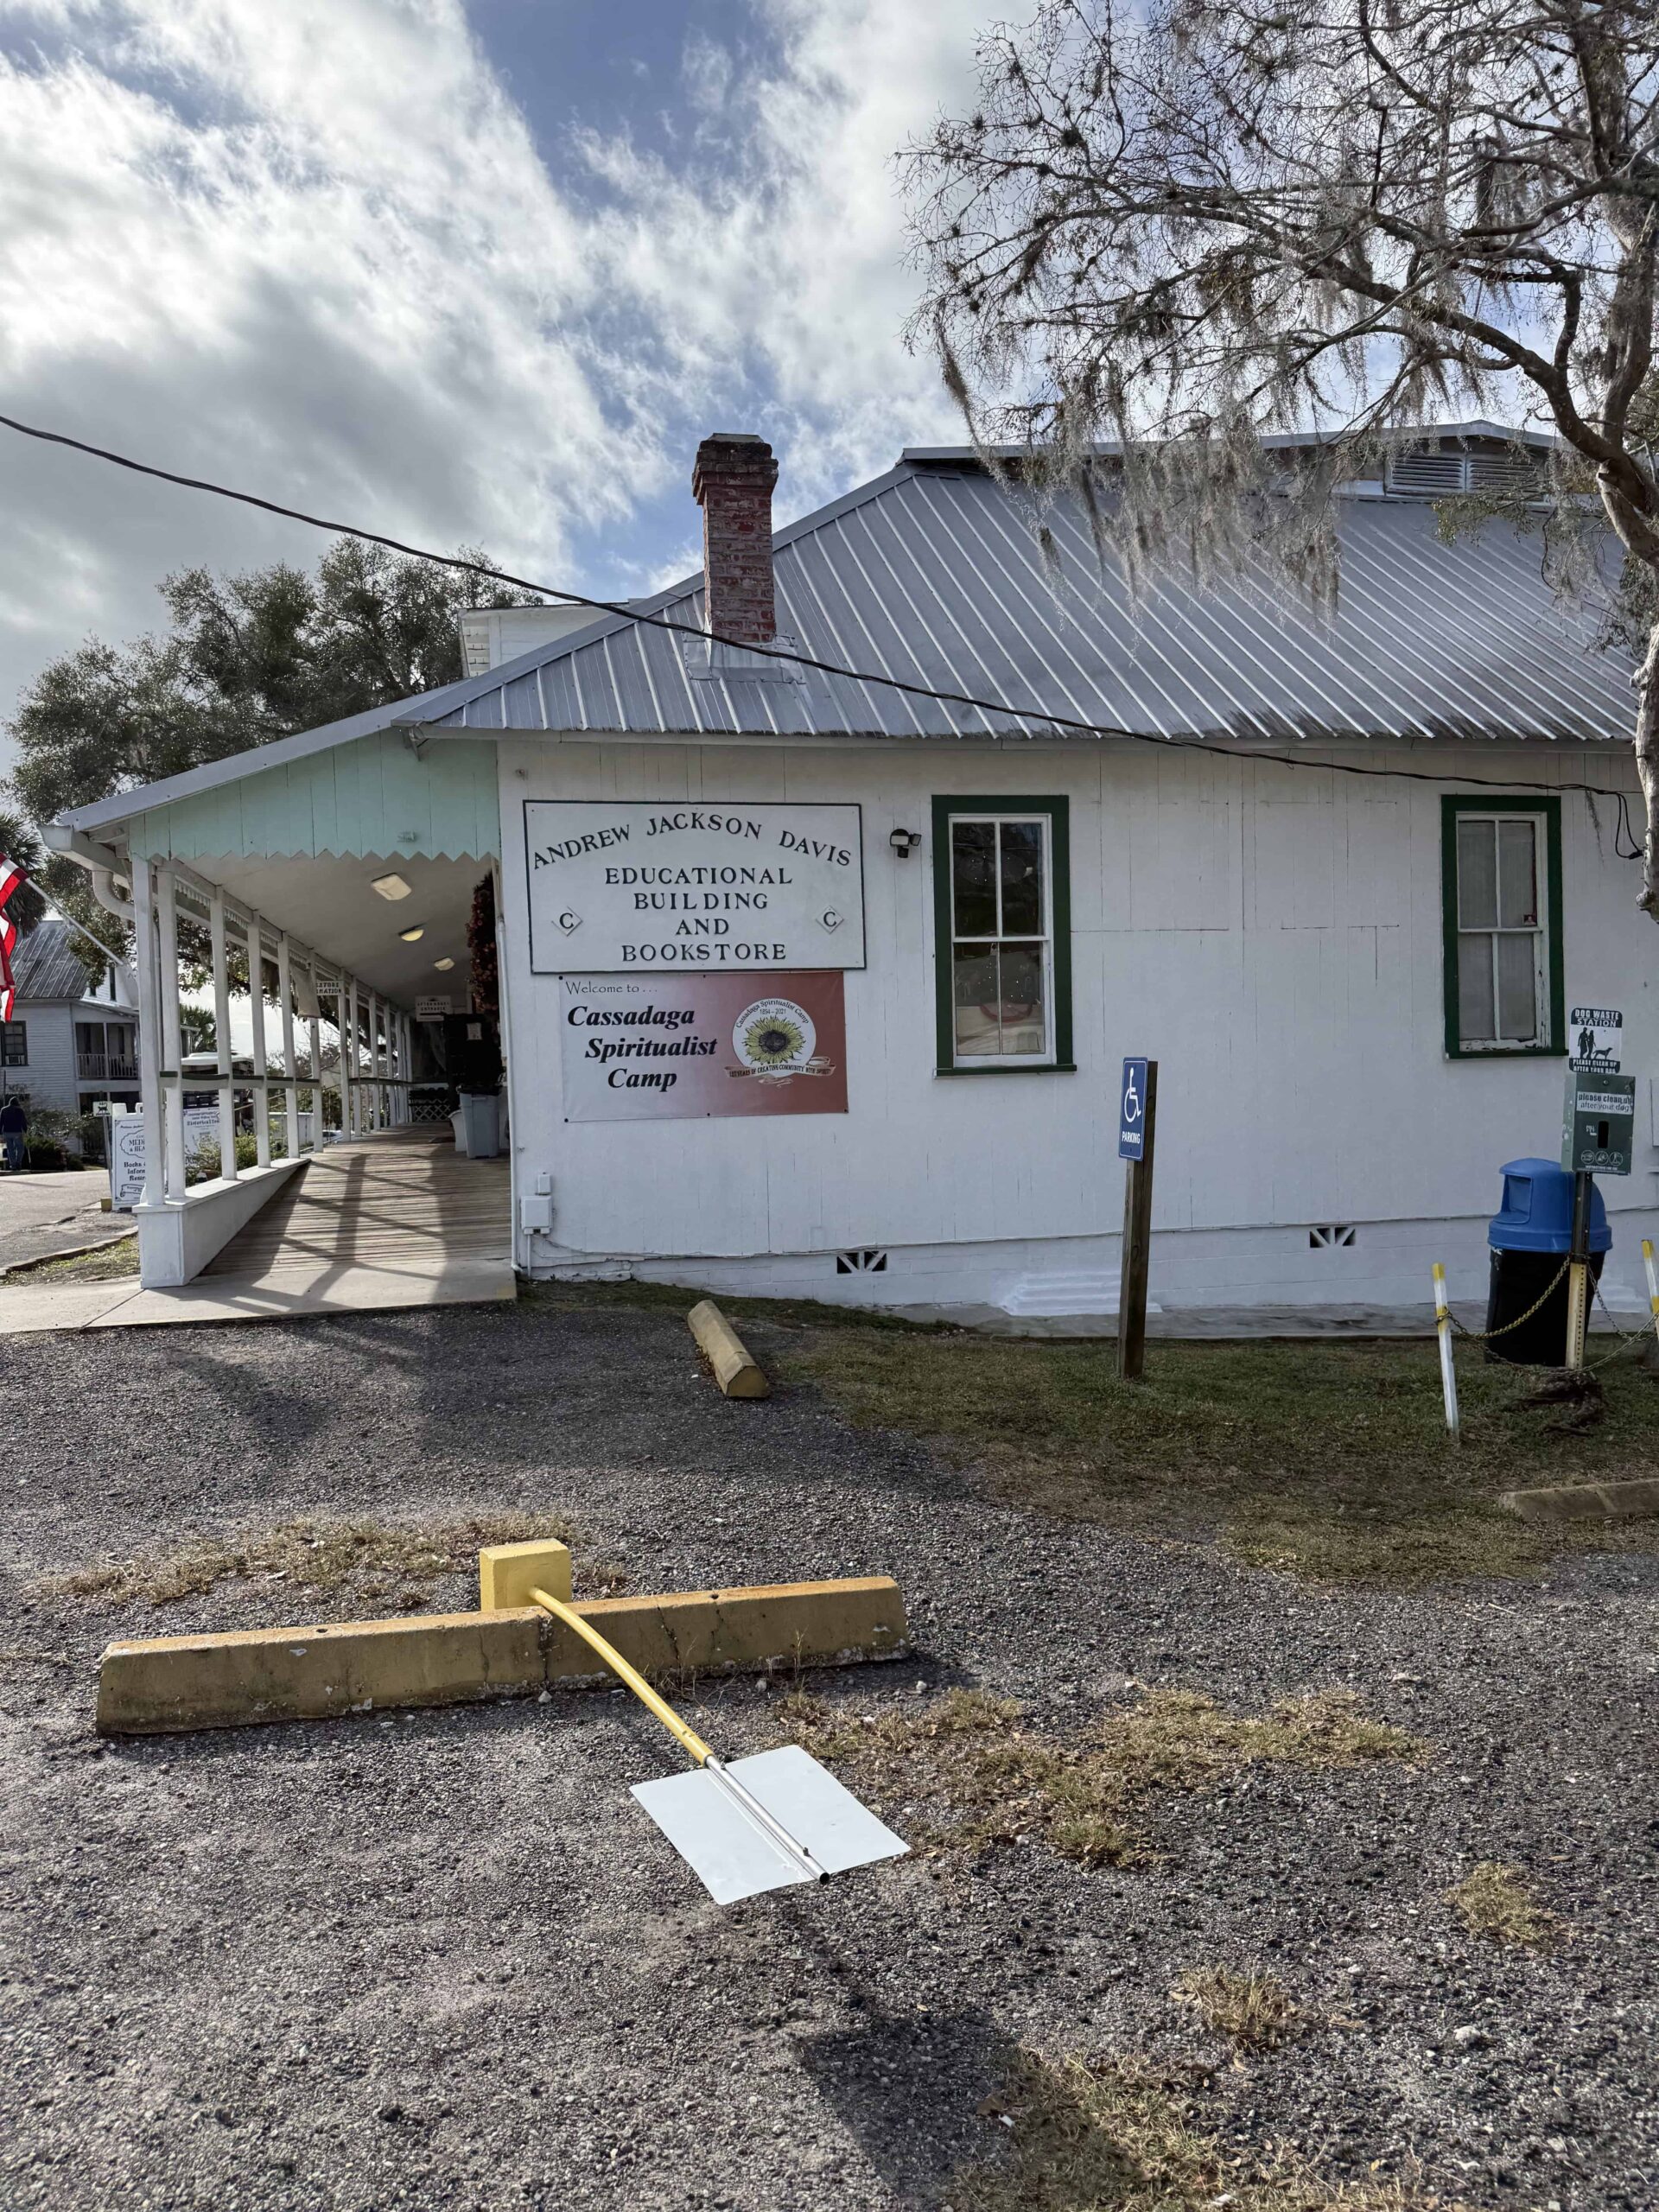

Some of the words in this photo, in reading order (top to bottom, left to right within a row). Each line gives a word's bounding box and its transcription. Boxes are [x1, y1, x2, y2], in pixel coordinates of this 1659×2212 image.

[534, 824, 630, 870] ANDREW
[647, 812, 762, 840] JACKSON
[779, 830, 851, 866] DAVIS
[605, 867, 792, 885] EDUCATIONAL
[633, 893, 768, 910] BUILDING
[559, 912, 574, 929] C
[675, 918, 729, 936] AND
[823, 911, 836, 927] C
[621, 944, 786, 962] BOOKSTORE
[565, 981, 623, 995] Welcome
[567, 1005, 695, 1030] Cassadaga
[736, 1003, 761, 1028] Cassadaga
[760, 999, 795, 1010] Spiritualist
[795, 1008, 809, 1024] Camp
[1574, 1008, 1591, 1017] DOG
[1592, 1010, 1619, 1020] WASTE
[1577, 1018, 1617, 1027] STATION
[584, 1036, 718, 1064] Spiritualist
[757, 1065, 779, 1073] CREATING
[607, 1068, 677, 1092] Camp
[1603, 1095, 1622, 1103] clean
[1122, 1131, 1141, 1144] PARKING
